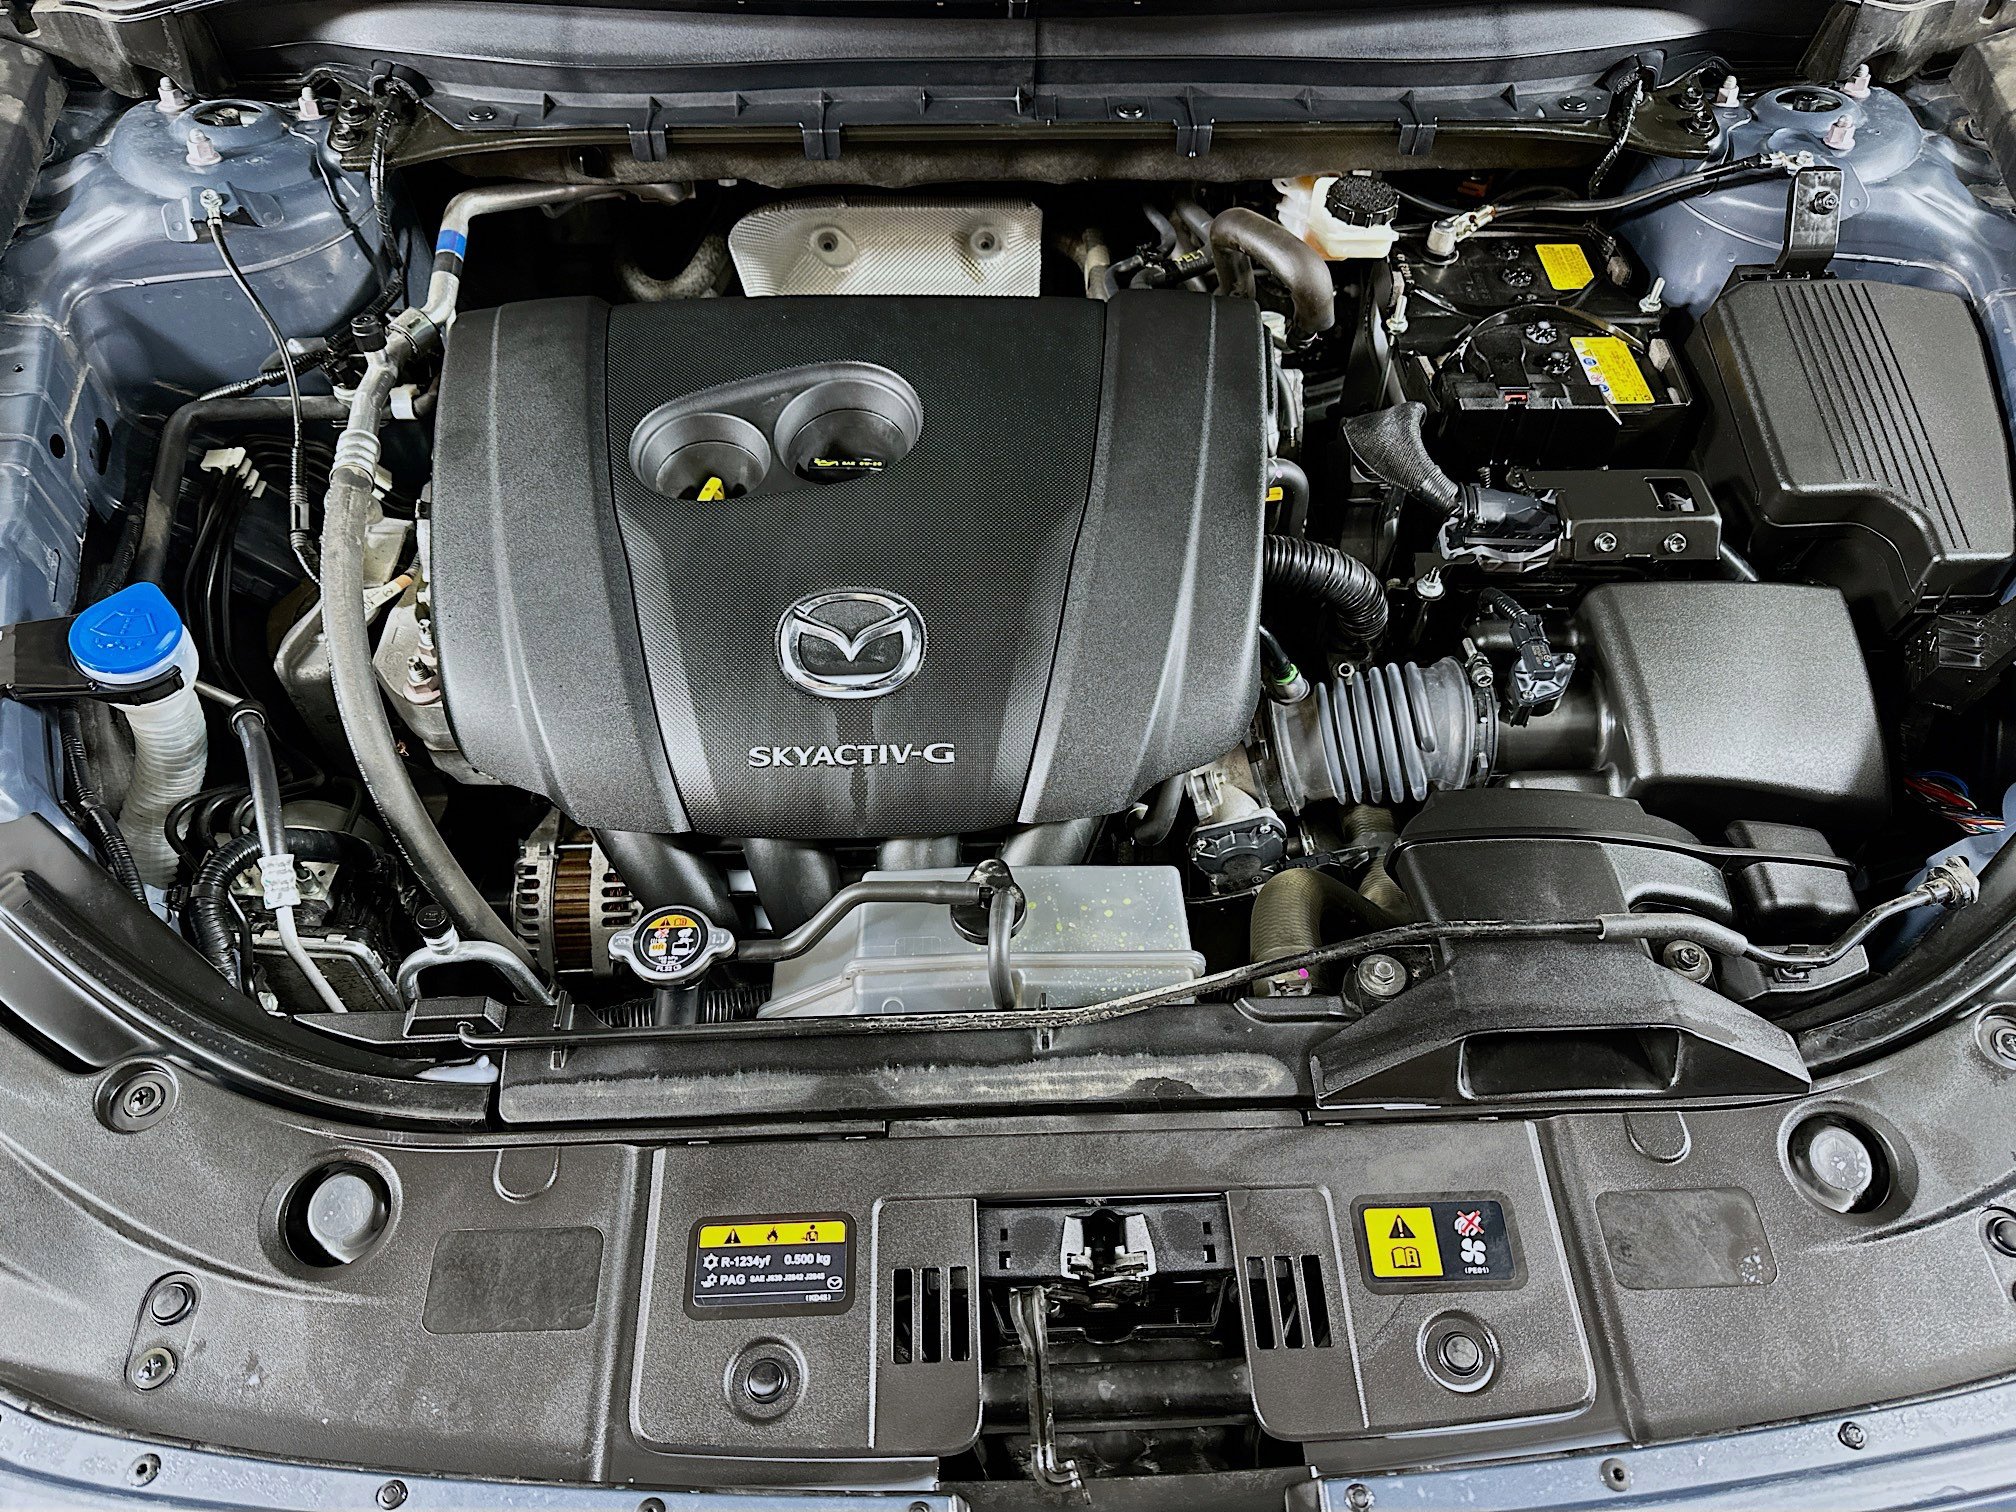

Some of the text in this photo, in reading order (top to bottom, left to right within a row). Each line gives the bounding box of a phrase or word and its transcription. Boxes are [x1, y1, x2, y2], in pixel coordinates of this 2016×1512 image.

[749, 743, 955, 768] SKYACTIV-G
[720, 1253, 832, 1269] R-1234yf 0.500 kg
[720, 1274, 747, 1286] PAG
